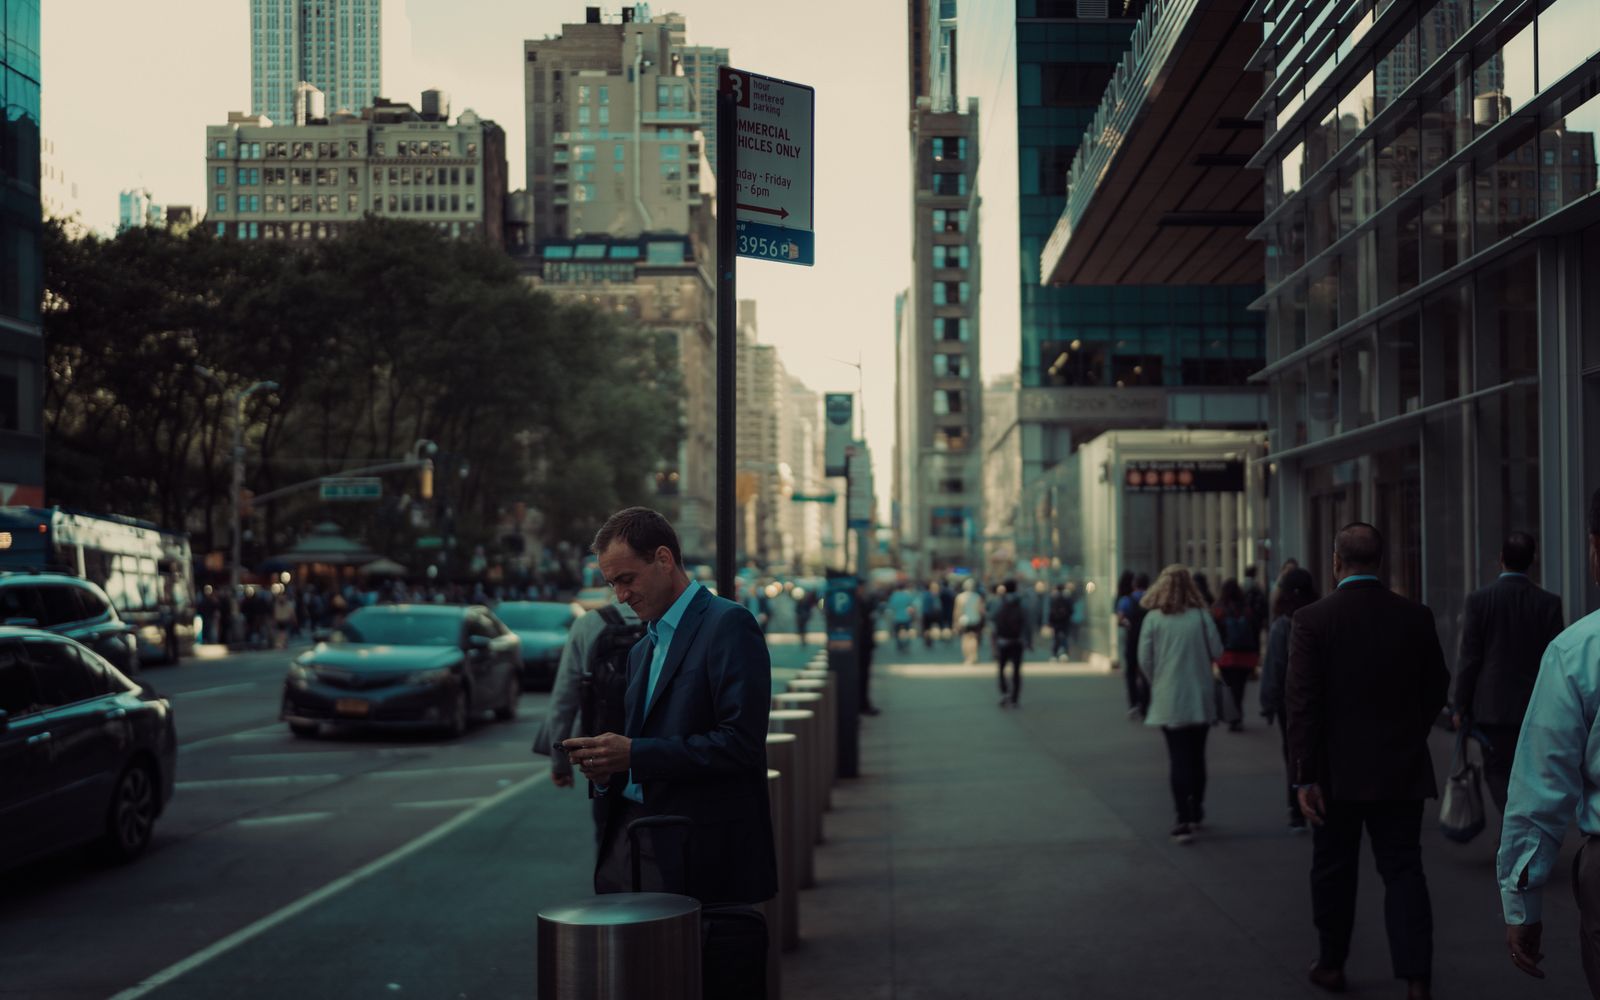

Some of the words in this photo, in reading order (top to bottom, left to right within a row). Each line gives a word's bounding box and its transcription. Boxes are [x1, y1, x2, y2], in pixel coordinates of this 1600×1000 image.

[728, 73, 743, 103] 3
[753, 80, 770, 91] hour
[753, 92, 785, 105] metered
[753, 103, 781, 117] parking
[738, 119, 791, 141] MMERCIAL
[738, 135, 773, 153] HICLES
[776, 143, 801, 159] ONLY
[736, 169, 757, 183] nday
[765, 173, 791, 189] Friday
[750, 184, 770, 197] 6pm
[739, 235, 778, 257] 3956
